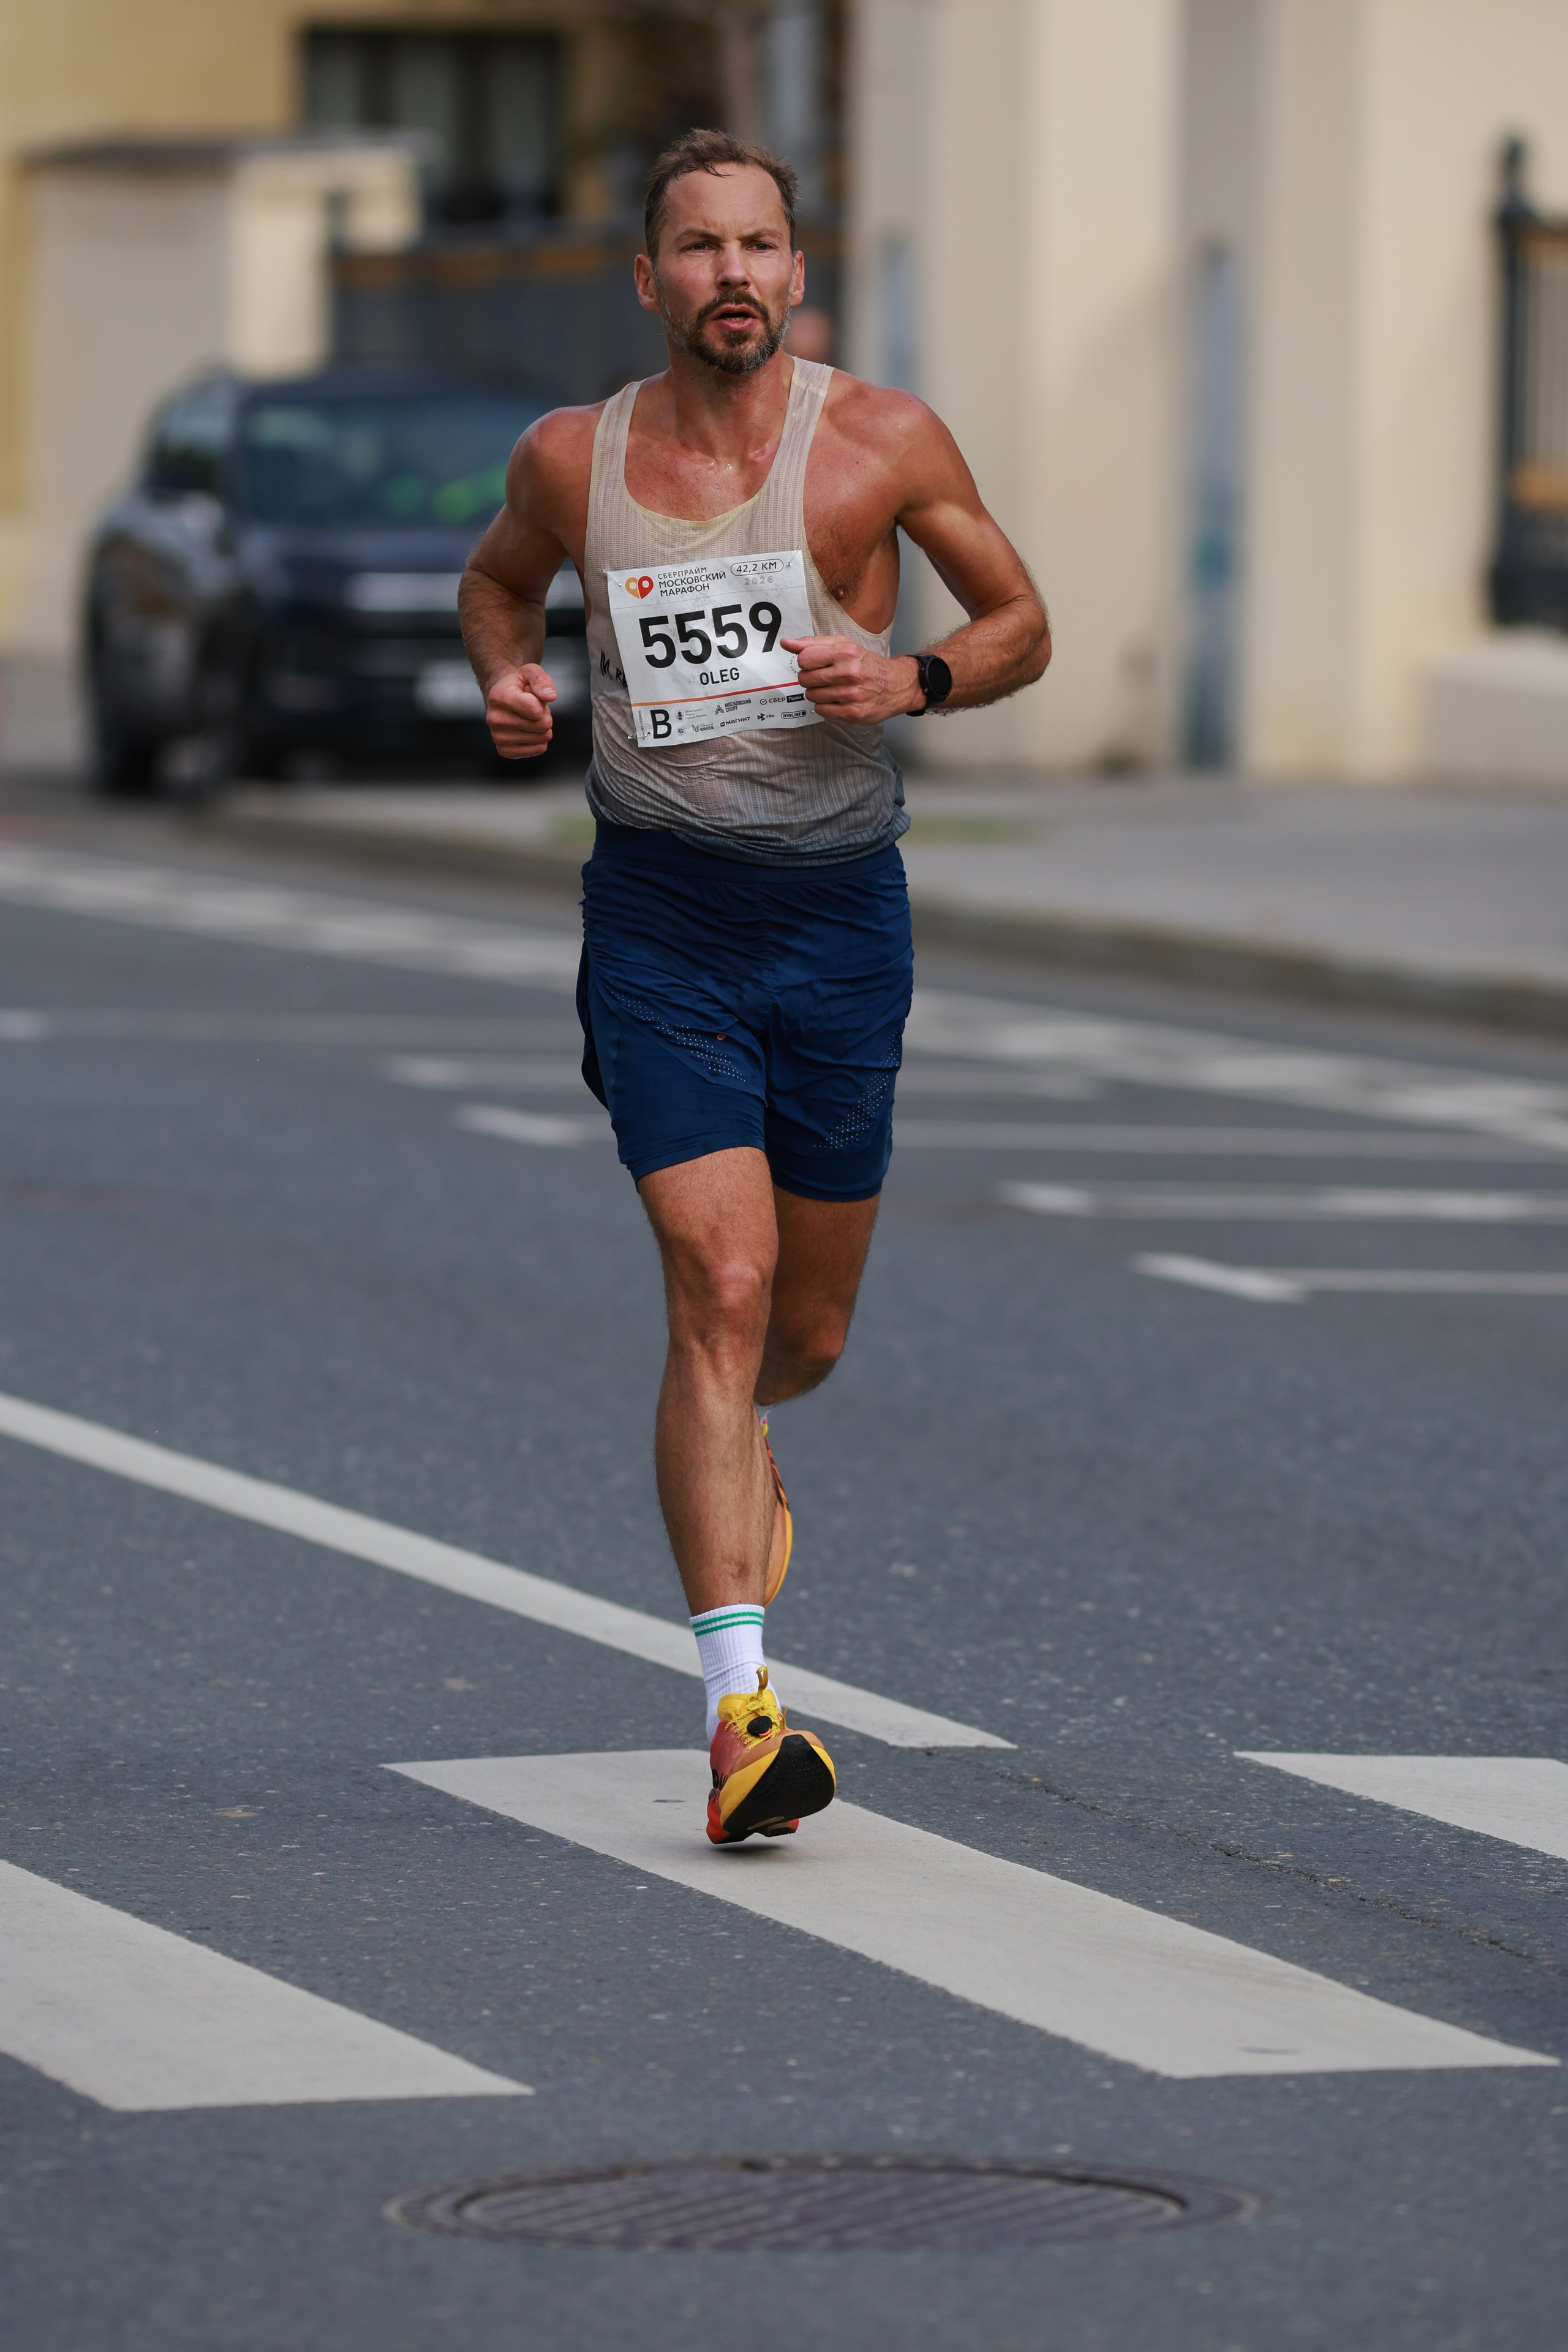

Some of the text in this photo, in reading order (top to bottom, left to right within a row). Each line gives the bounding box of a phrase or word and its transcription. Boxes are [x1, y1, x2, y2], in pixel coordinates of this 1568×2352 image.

[658, 567, 707, 579] СБЕРПРАЙМ
[736, 562, 777, 573] 42,2 КМ
[659, 571, 726, 588] МОСКОВСКИЙ
[744, 576, 773, 585] 2026
[660, 583, 709, 597] МАРАФОН
[639, 601, 782, 668] 5559
[699, 668, 739, 685] OLEG
[725, 698, 752, 707] МОСКОВСКИЙ
[650, 709, 672, 739] B
